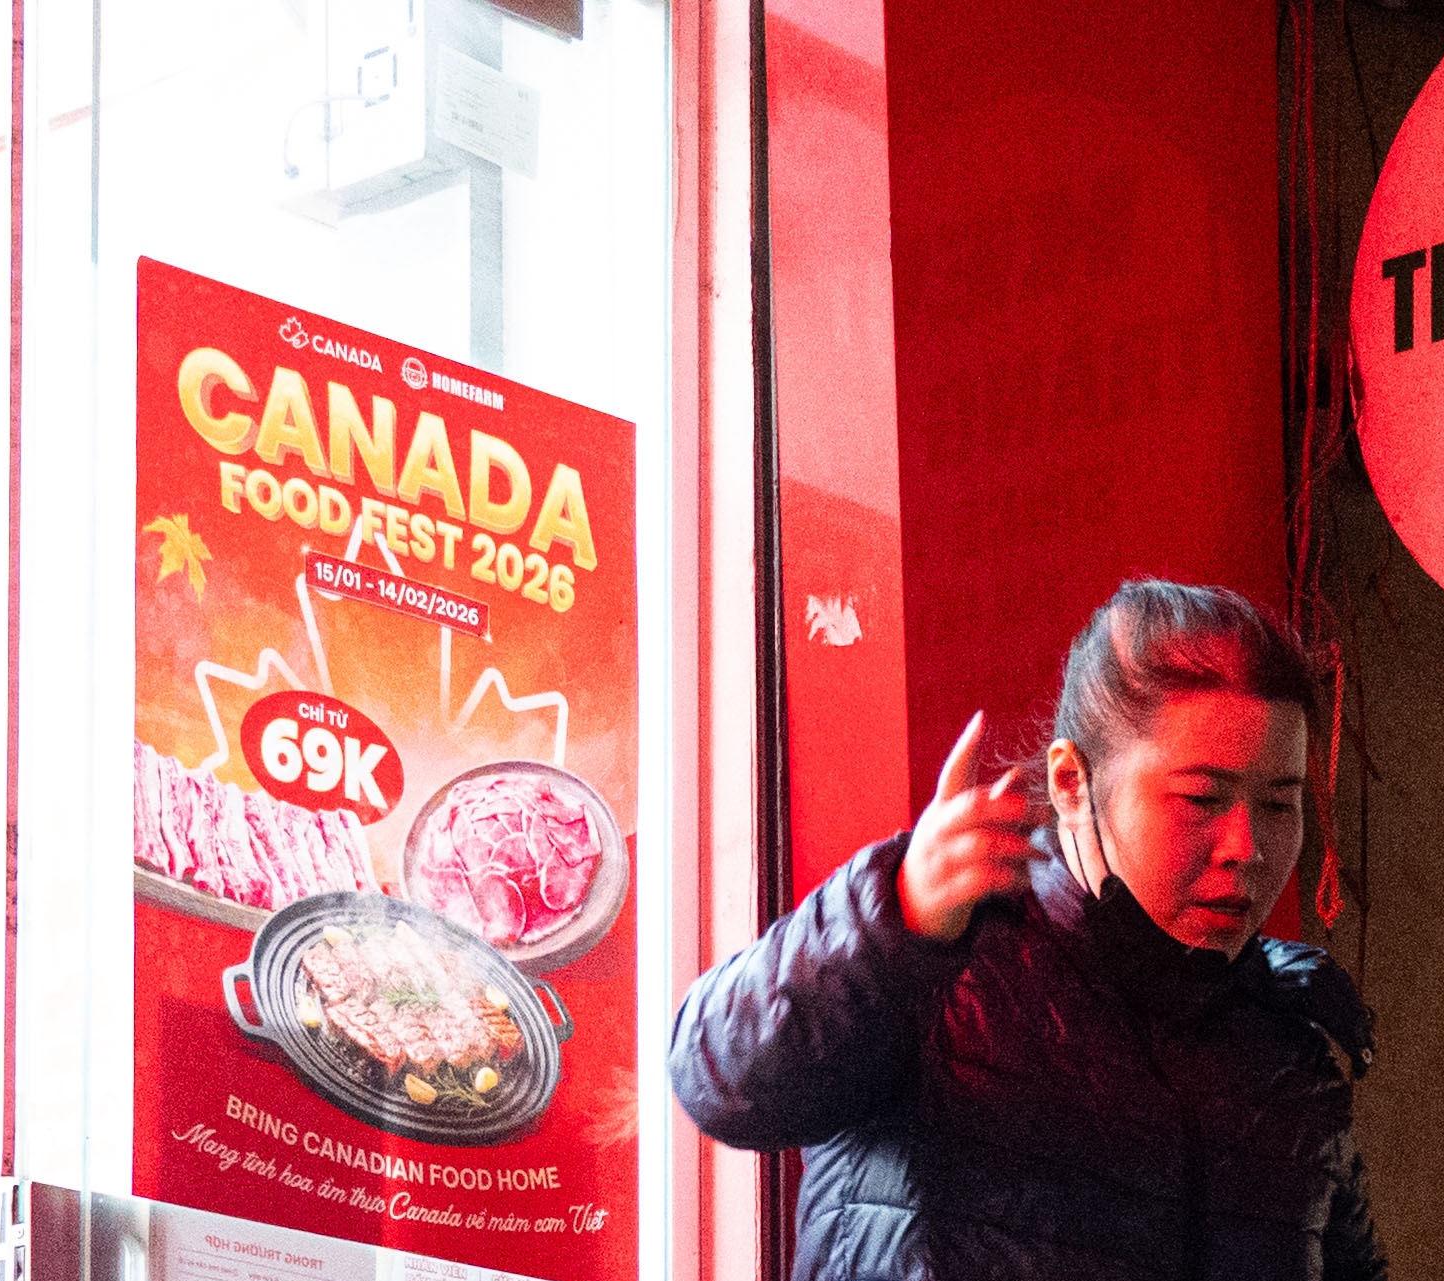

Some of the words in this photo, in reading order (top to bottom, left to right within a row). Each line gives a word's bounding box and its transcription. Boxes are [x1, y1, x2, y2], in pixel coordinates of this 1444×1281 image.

[312, 334, 383, 375] CANADA
[431, 370, 505, 411] HOMEFARM
[178, 345, 599, 572] CANADA
[219, 461, 352, 535] FOOD
[360, 495, 463, 571] FEST
[470, 533, 576, 613] 2026
[314, 561, 363, 592] 15/01
[377, 578, 480, 627] 14/02/2026
[260, 717, 390, 811] 69K
[170, 1121, 244, 1171] Mang
[278, 1164, 314, 1192] hoa
[388, 1191, 463, 1227] Canada
[488, 1210, 531, 1233] mâm
[568, 1203, 609, 1234] Việt
[226, 1094, 298, 1147] BRING
[302, 1131, 424, 1183] CANADIAN
[429, 1164, 493, 1192] FOOD
[497, 1166, 561, 1192] HOME
